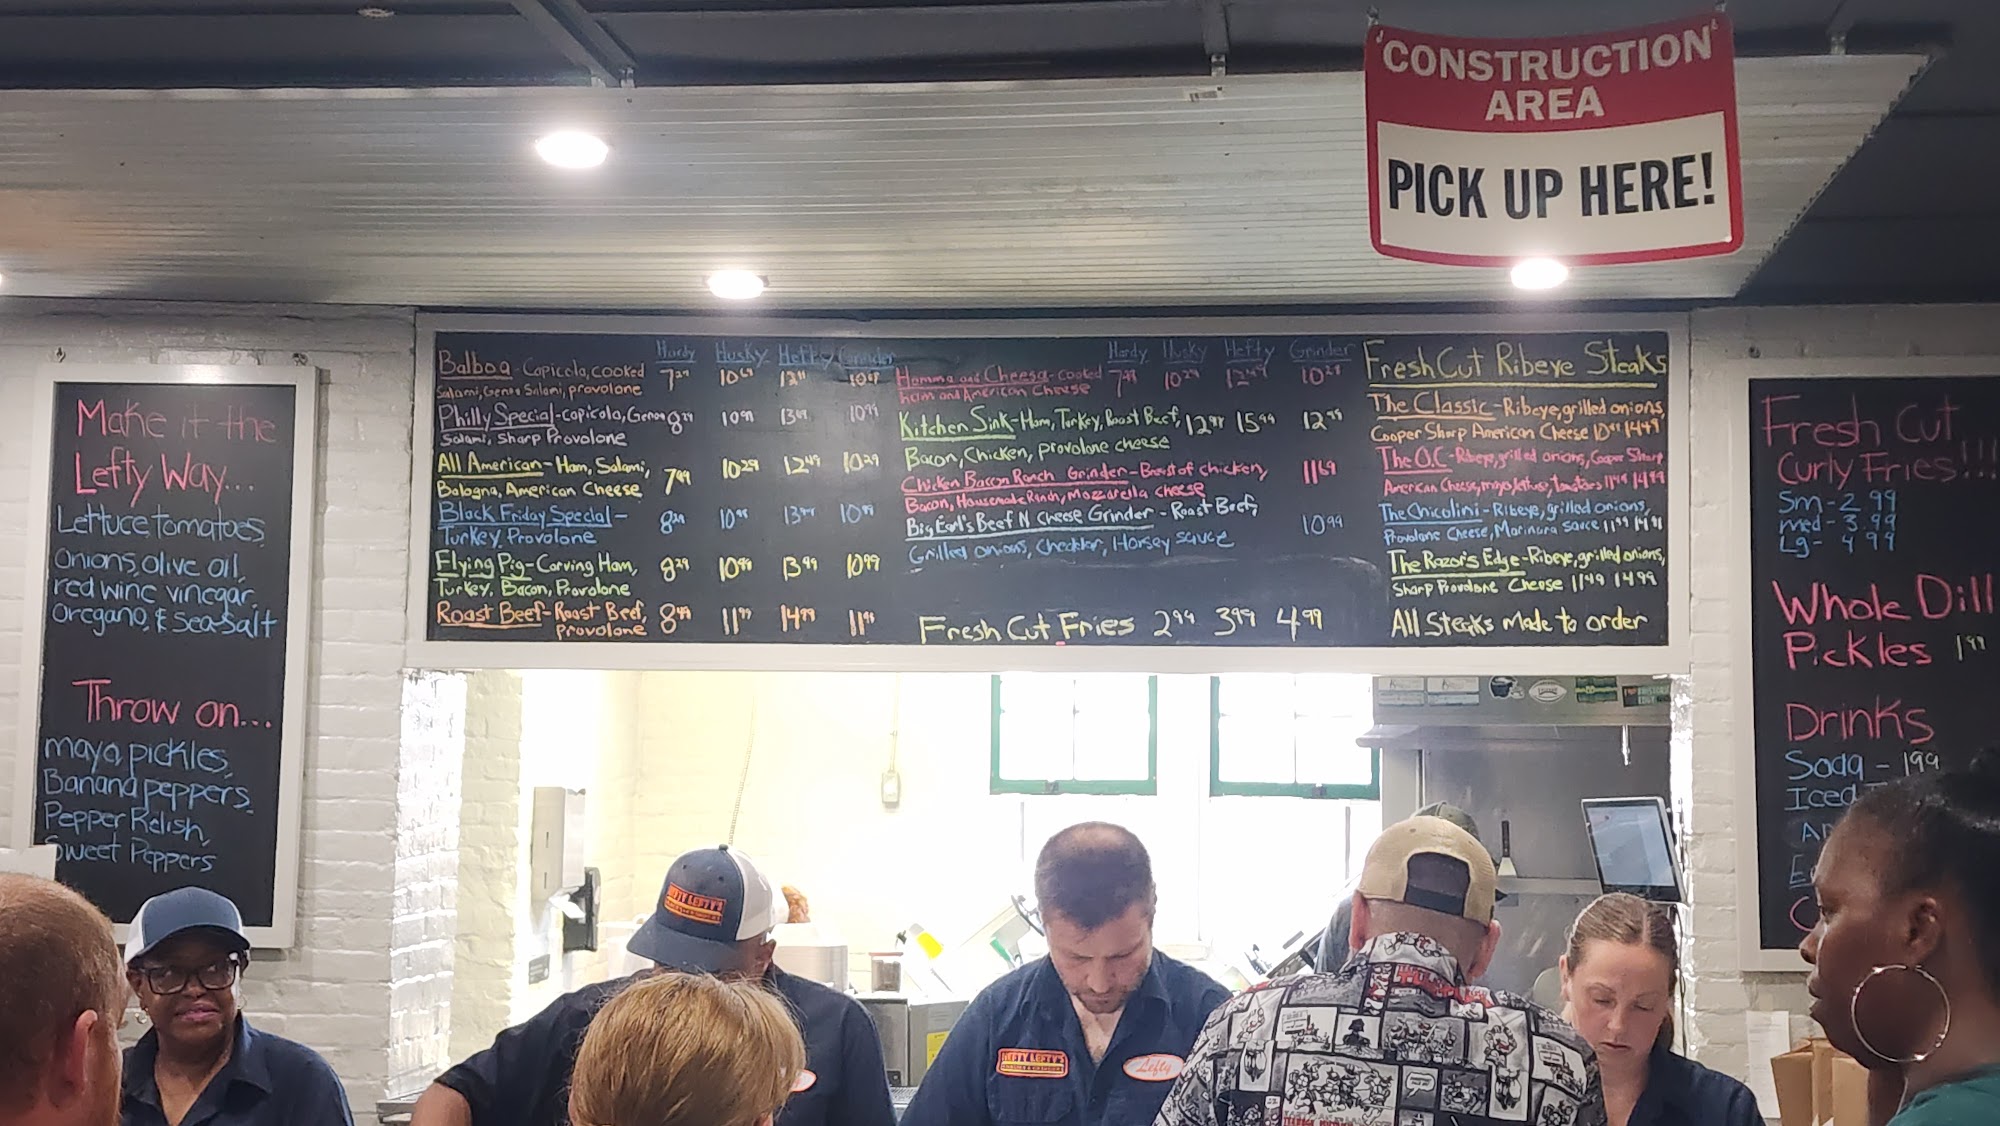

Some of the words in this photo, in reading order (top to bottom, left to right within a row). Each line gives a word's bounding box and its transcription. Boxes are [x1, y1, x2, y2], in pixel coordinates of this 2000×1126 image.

[1382, 25, 1714, 82] CONSTRUCTION
[1484, 85, 1605, 122] AREA
[1387, 158, 1488, 219] PICK
[1504, 168, 1563, 221] UP
[1580, 151, 1716, 218] HERE!
[438, 349, 511, 376] Balboa
[1362, 339, 1436, 380] Fresh
[1437, 346, 1485, 379] Cut
[1495, 342, 1576, 382] Ribeye
[1585, 339, 1667, 377] Steaks
[438, 403, 492, 431] Philly
[1367, 392, 1410, 414] The
[1413, 391, 1493, 416] Classic
[77, 399, 167, 438] Make
[182, 401, 209, 438] it
[218, 404, 276, 443] the
[899, 410, 969, 439] Kitchen
[1105, 407, 1139, 426] Roast
[1370, 425, 1422, 444] Cooper
[1426, 422, 1467, 442] Sharp
[1472, 422, 1535, 440] American
[1540, 422, 1589, 441] Cheese
[1761, 394, 1880, 447] Fresh
[1897, 394, 1960, 443] Cut
[547, 426, 628, 447] Provolone
[437, 452, 462, 473] All
[1376, 446, 1411, 470] The
[1778, 451, 1853, 490] Curly
[75, 446, 153, 508] Lefty
[506, 481, 576, 498] American
[582, 481, 643, 498] Cheese
[901, 474, 961, 494] Chicken
[963, 469, 1010, 490] Bacon
[1011, 467, 1056, 485] Ranch
[439, 501, 495, 523] Black
[500, 502, 545, 528] Friday
[550, 503, 611, 526] Special
[906, 516, 933, 538] Big
[976, 509, 1014, 532] Beef
[1018, 510, 1030, 528] N
[1088, 503, 1154, 523] Grinder
[1171, 497, 1213, 520] Roast
[1378, 503, 1407, 522] The
[507, 527, 597, 545] Provolone
[909, 542, 967, 565] Grilled
[1112, 534, 1172, 556] Horsey
[141, 551, 200, 577] olive
[434, 550, 495, 577] Flying
[1387, 549, 1422, 574] The
[53, 575, 94, 598] red
[101, 580, 157, 603] wine
[556, 578, 631, 597] Provolone
[1508, 576, 1564, 593] Cheese
[1772, 579, 1911, 626] Whole
[1916, 572, 1994, 620] Dill
[436, 600, 494, 623] Roast
[554, 600, 600, 622] Roast
[1391, 606, 1420, 637] All
[1424, 609, 1495, 637] Steaks
[1555, 605, 1578, 634] to
[919, 614, 1001, 644] Fresh
[1005, 612, 1051, 641] Cut
[1059, 612, 1135, 639] Fries
[1782, 629, 1933, 670] Pickles
[72, 678, 181, 725] Throw
[1786, 694, 1936, 745] Drinks
[1785, 750, 1864, 782] Soda
[43, 768, 138, 798] Banana
[1784, 782, 1859, 812] Iced
[43, 801, 126, 834] Pepper
[131, 837, 217, 873] Peppers
[1135, 1057, 1173, 1077] Lefty
